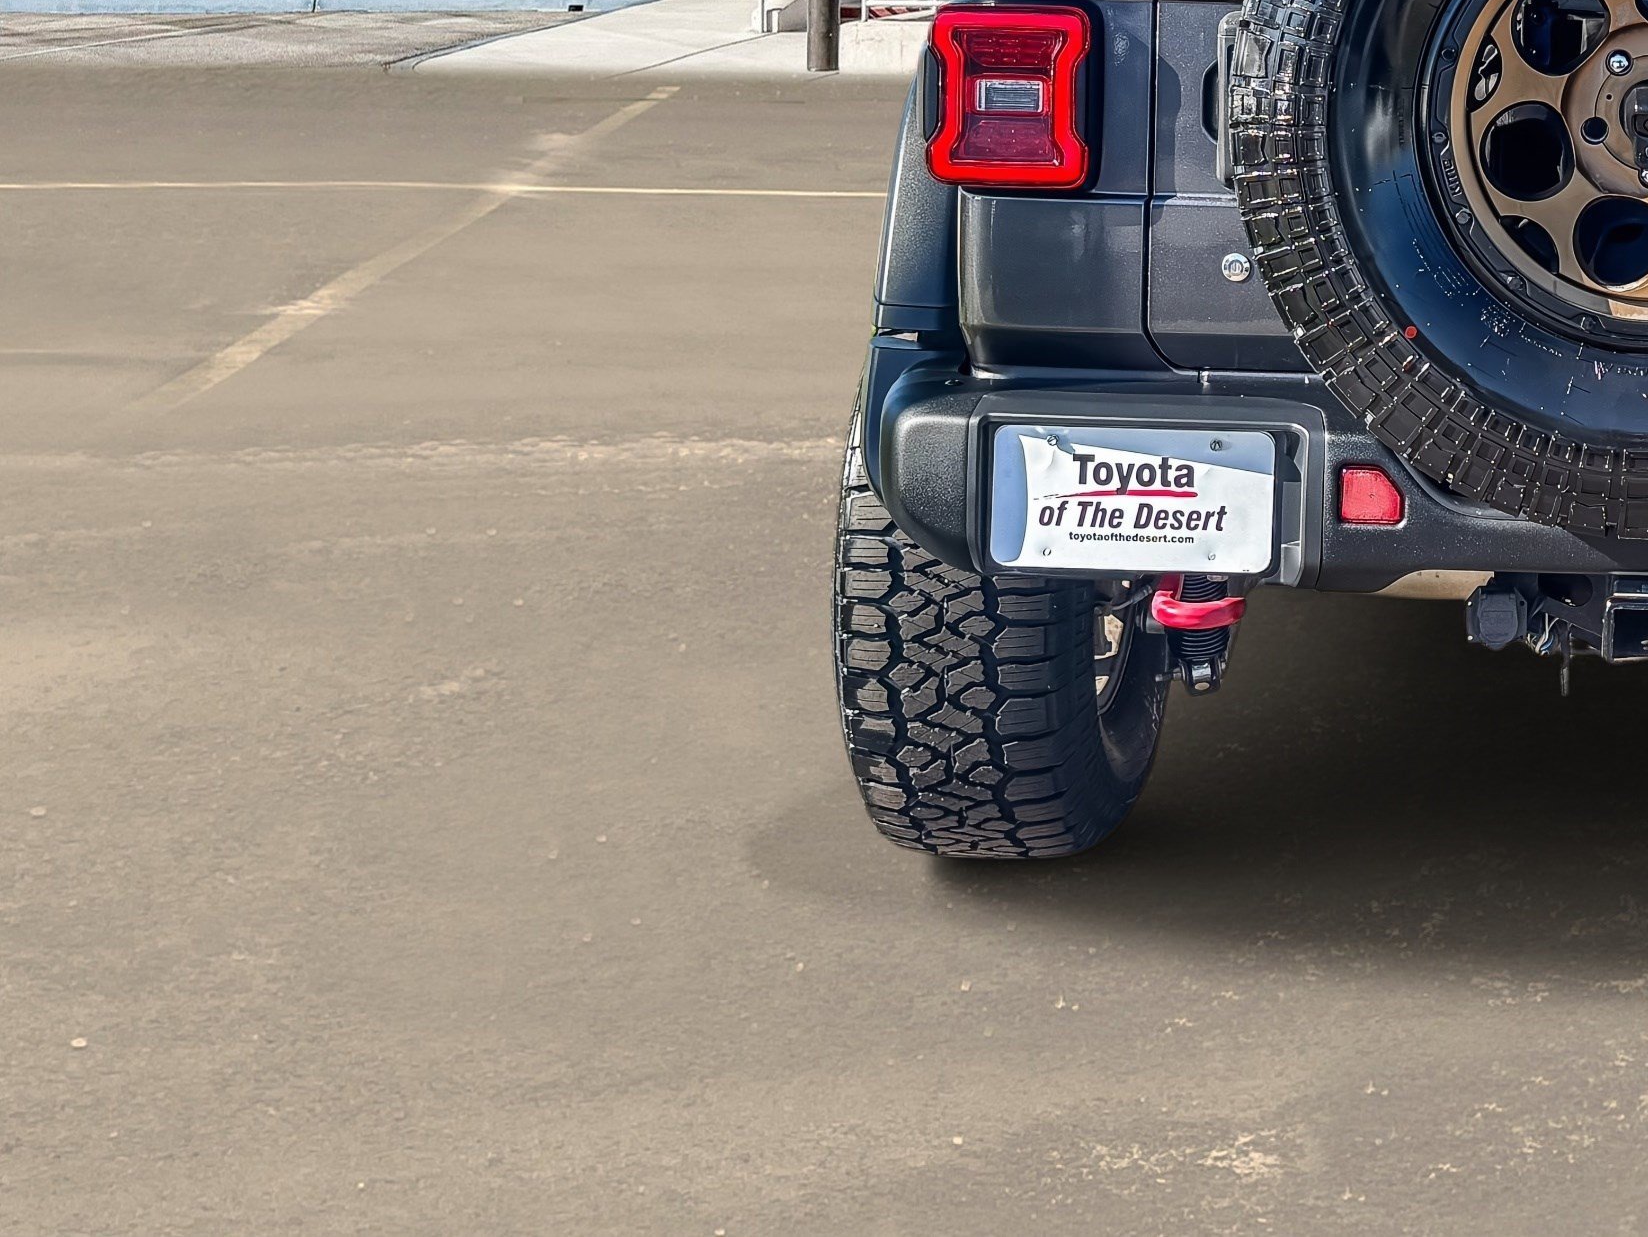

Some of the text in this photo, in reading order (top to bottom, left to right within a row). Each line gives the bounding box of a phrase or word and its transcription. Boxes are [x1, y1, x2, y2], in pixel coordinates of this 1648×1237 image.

[1072, 452, 1196, 496] Toyota
[1038, 500, 1228, 532] of The Desert
[1068, 531, 1195, 544] toyotaofthedesert.com
